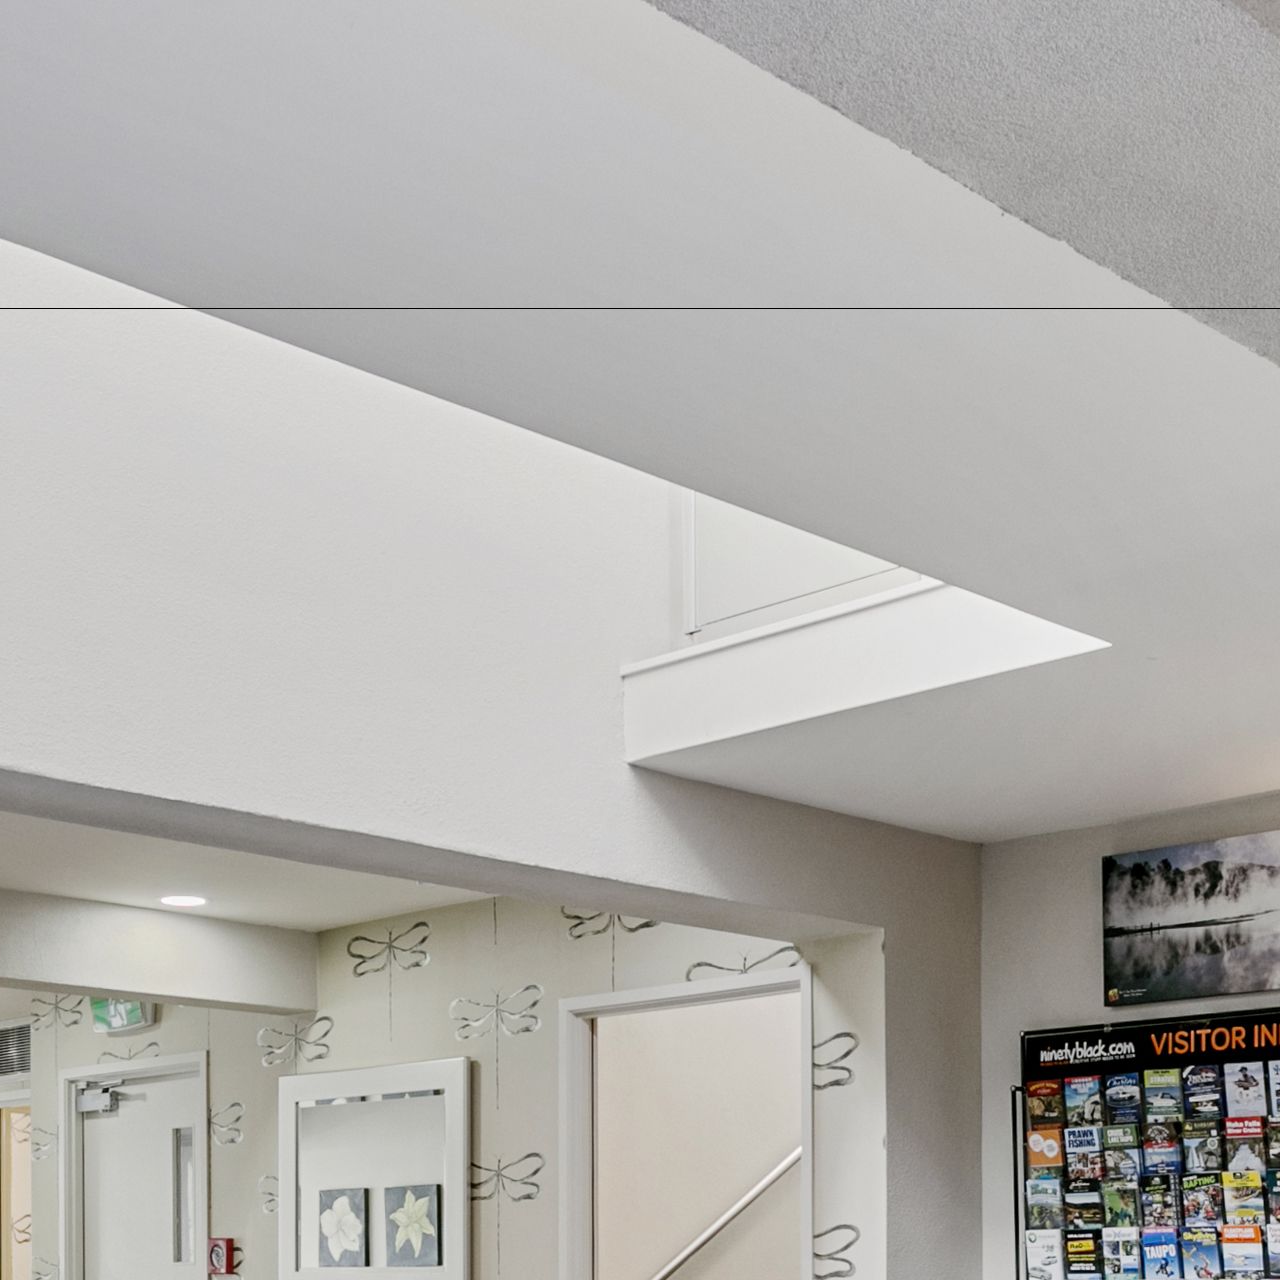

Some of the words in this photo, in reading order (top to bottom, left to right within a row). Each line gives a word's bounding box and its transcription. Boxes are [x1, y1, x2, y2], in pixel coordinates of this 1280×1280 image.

[1151, 1026, 1247, 1056] VISITOR
[1040, 1039, 1136, 1064] ninetyblack.com
[1226, 1120, 1244, 1128] Huka
[1245, 1118, 1262, 1127] Falls
[1067, 1128, 1095, 1139] PRAWN
[1068, 1138, 1096, 1149] FISHING
[1183, 1175, 1216, 1189] RAFTING
[1144, 1245, 1177, 1259] TAUPO
